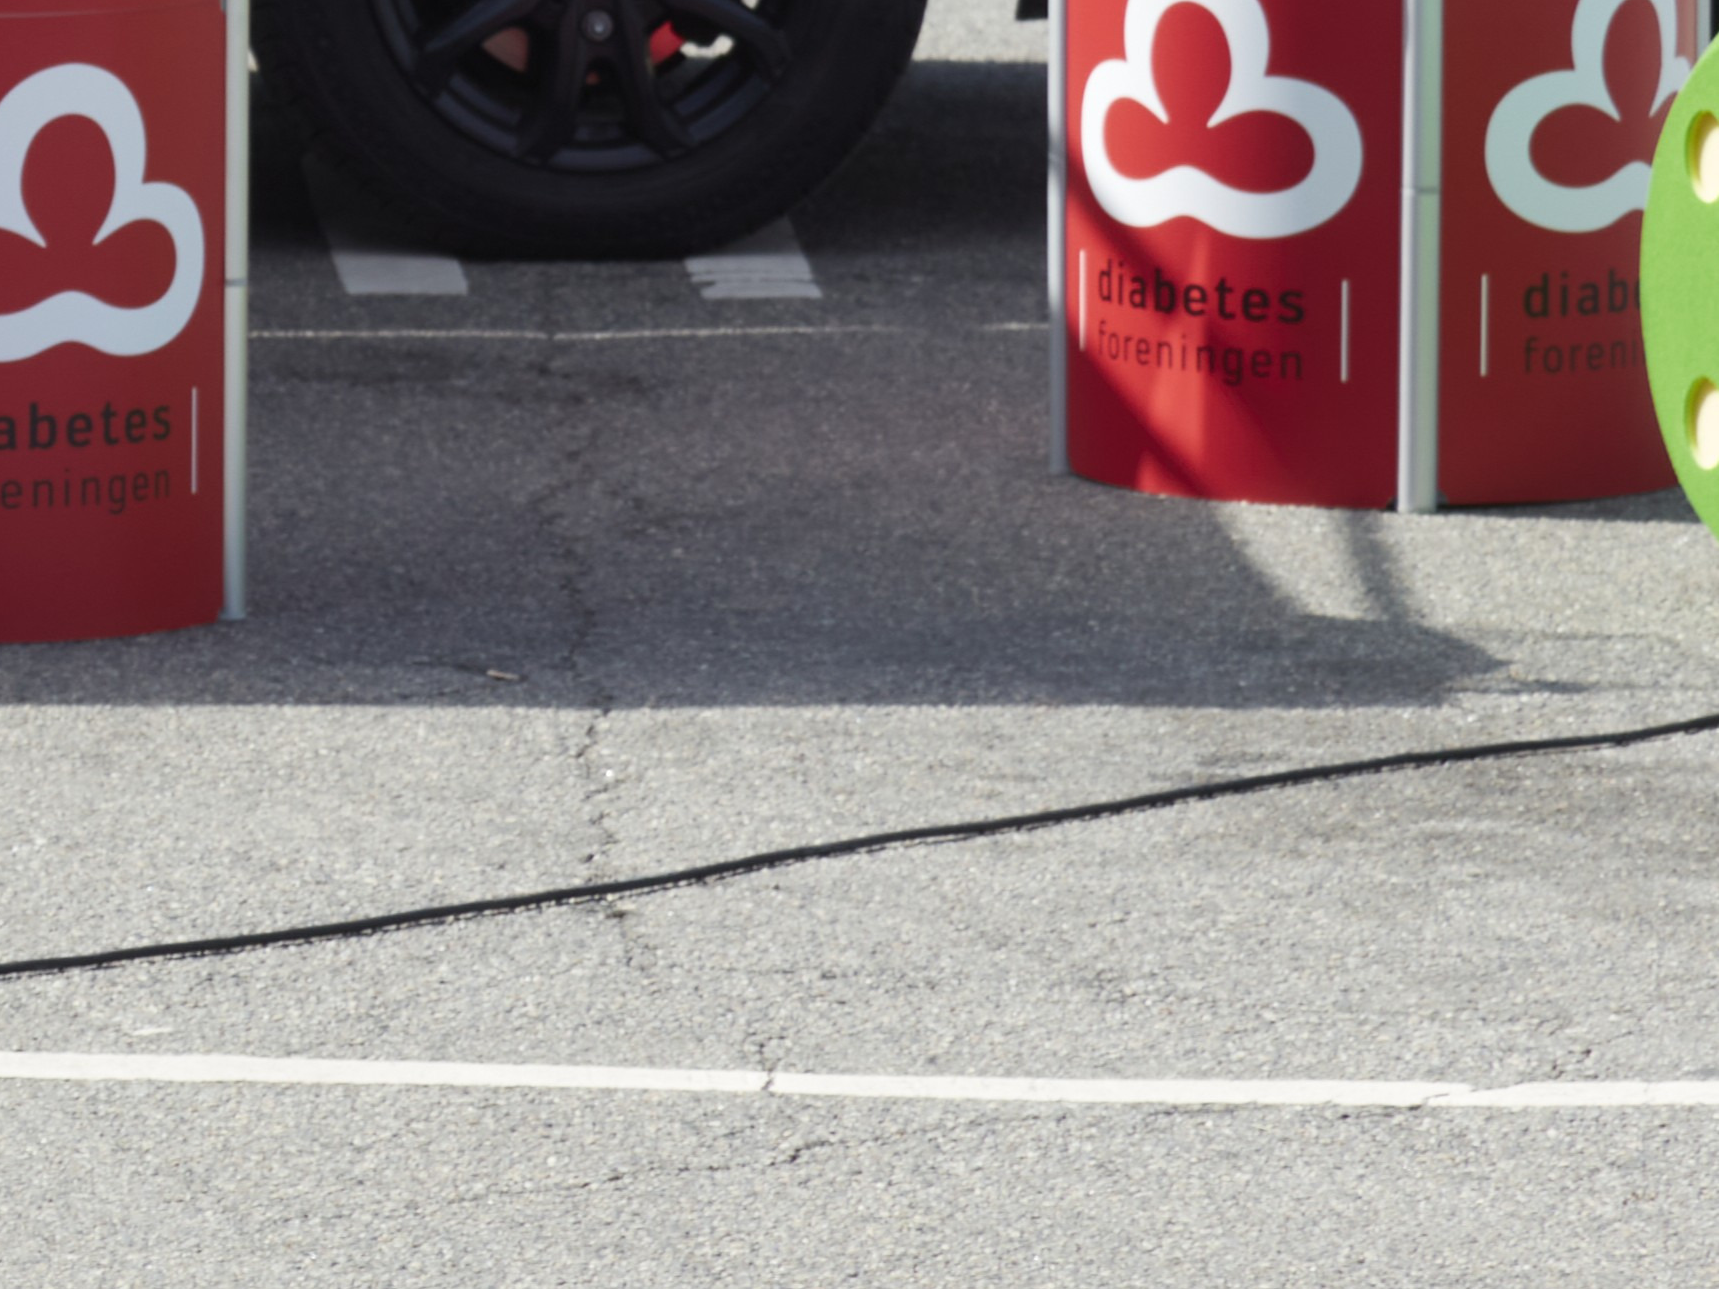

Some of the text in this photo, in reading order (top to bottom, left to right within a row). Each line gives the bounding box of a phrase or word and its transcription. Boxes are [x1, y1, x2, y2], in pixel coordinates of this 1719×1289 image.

[1097, 260, 1305, 324] diabetes
[1522, 267, 1641, 319] diab
[1097, 319, 1303, 386] foreningen
[1524, 336, 1638, 376] foreni
